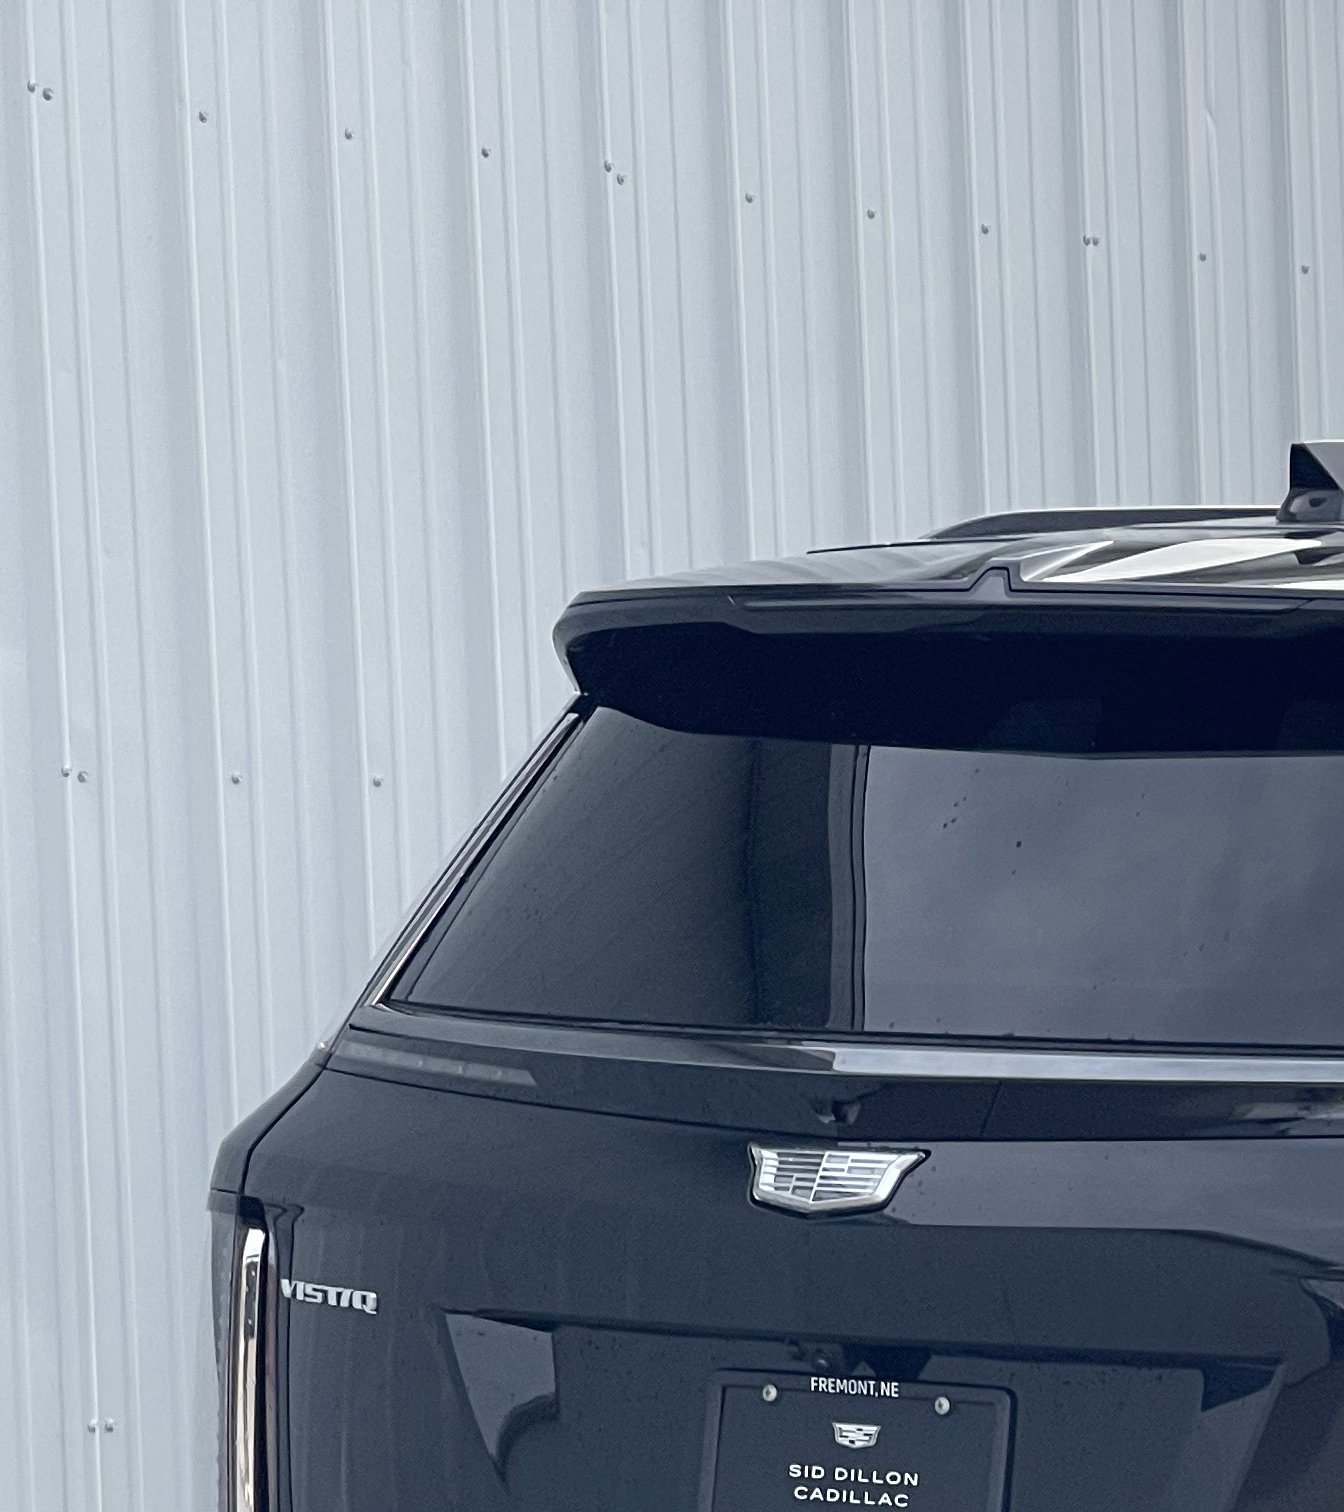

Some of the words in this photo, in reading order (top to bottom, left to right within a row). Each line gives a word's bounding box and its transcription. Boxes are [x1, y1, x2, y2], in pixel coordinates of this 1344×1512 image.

[280, 1278, 378, 1315] VISTIQ
[788, 1463, 825, 1480] SID
[834, 1466, 919, 1487] DILLON
[793, 1486, 910, 1508] CADILLAC
